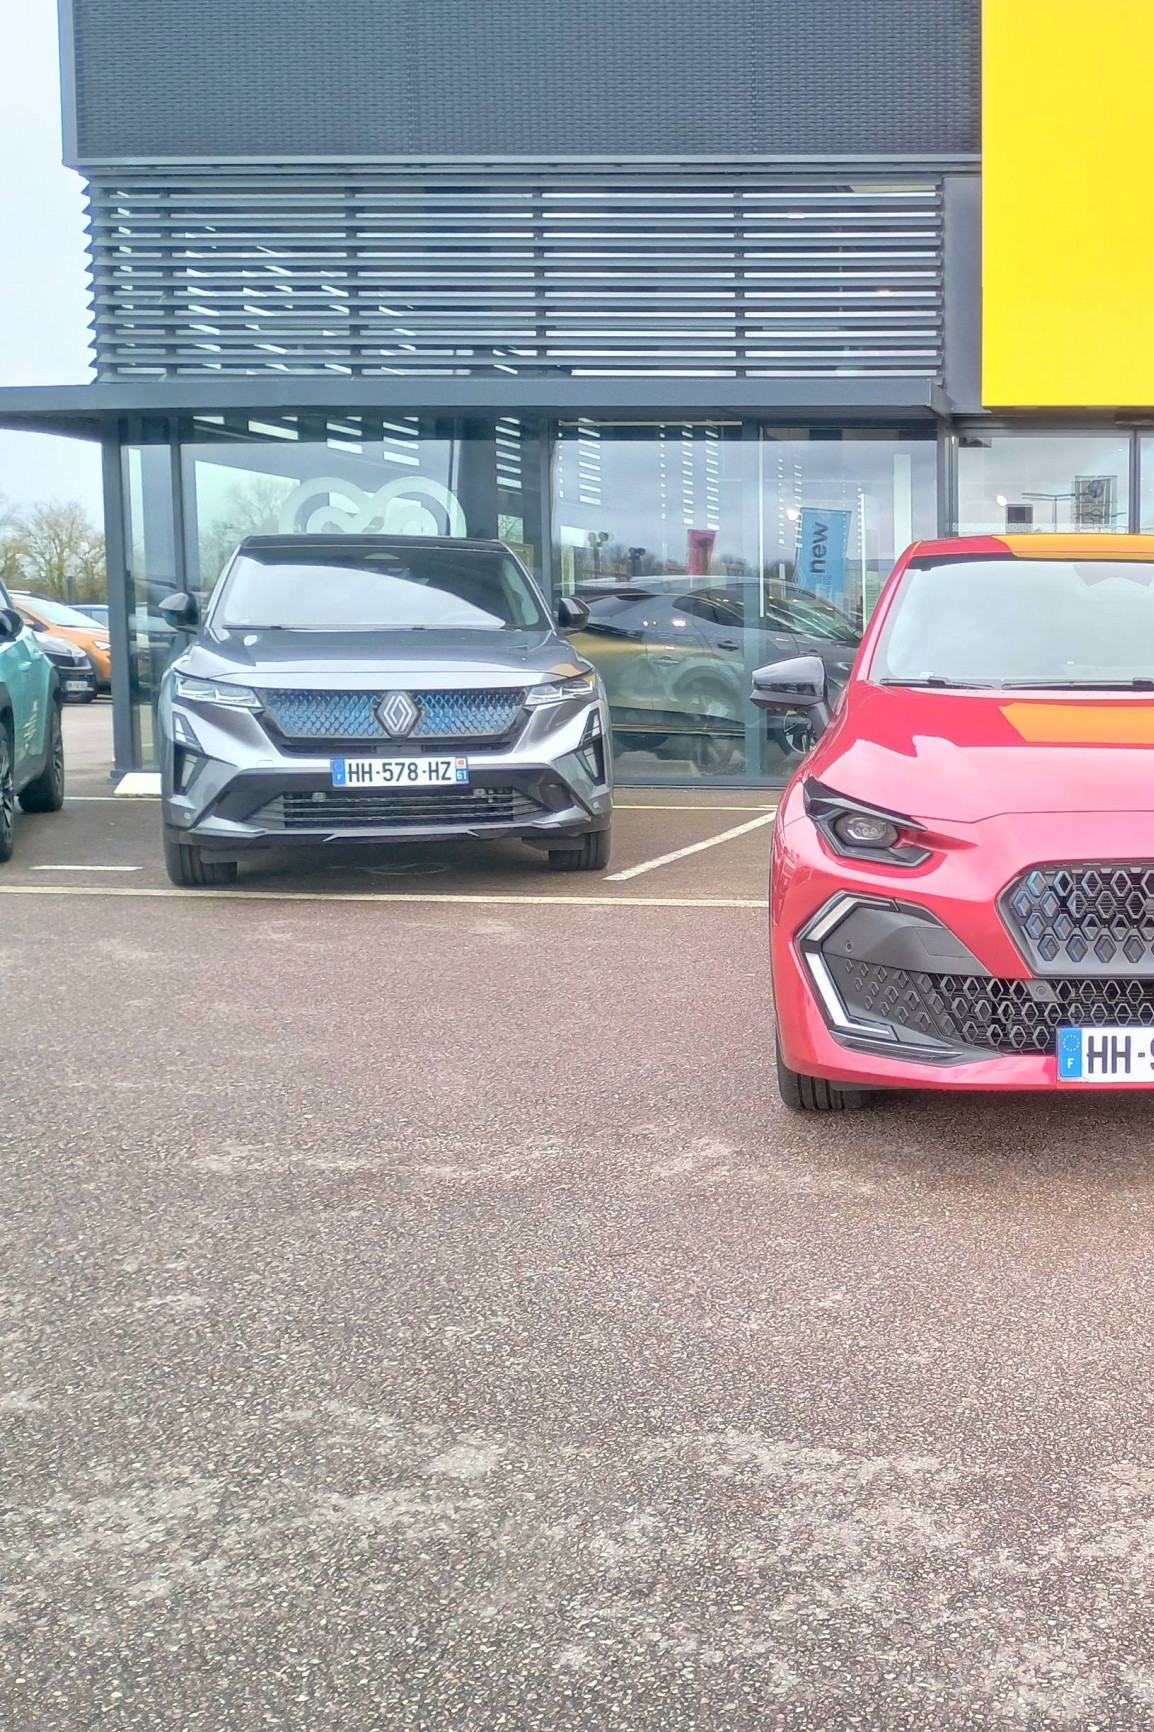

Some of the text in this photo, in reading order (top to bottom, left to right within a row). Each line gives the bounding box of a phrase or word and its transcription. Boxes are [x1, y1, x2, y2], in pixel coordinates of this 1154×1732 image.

[811, 522, 829, 574] new
[348, 761, 452, 783] HH-578-HZ
[456, 770, 467, 780] 61
[1066, 1057, 1074, 1069] F
